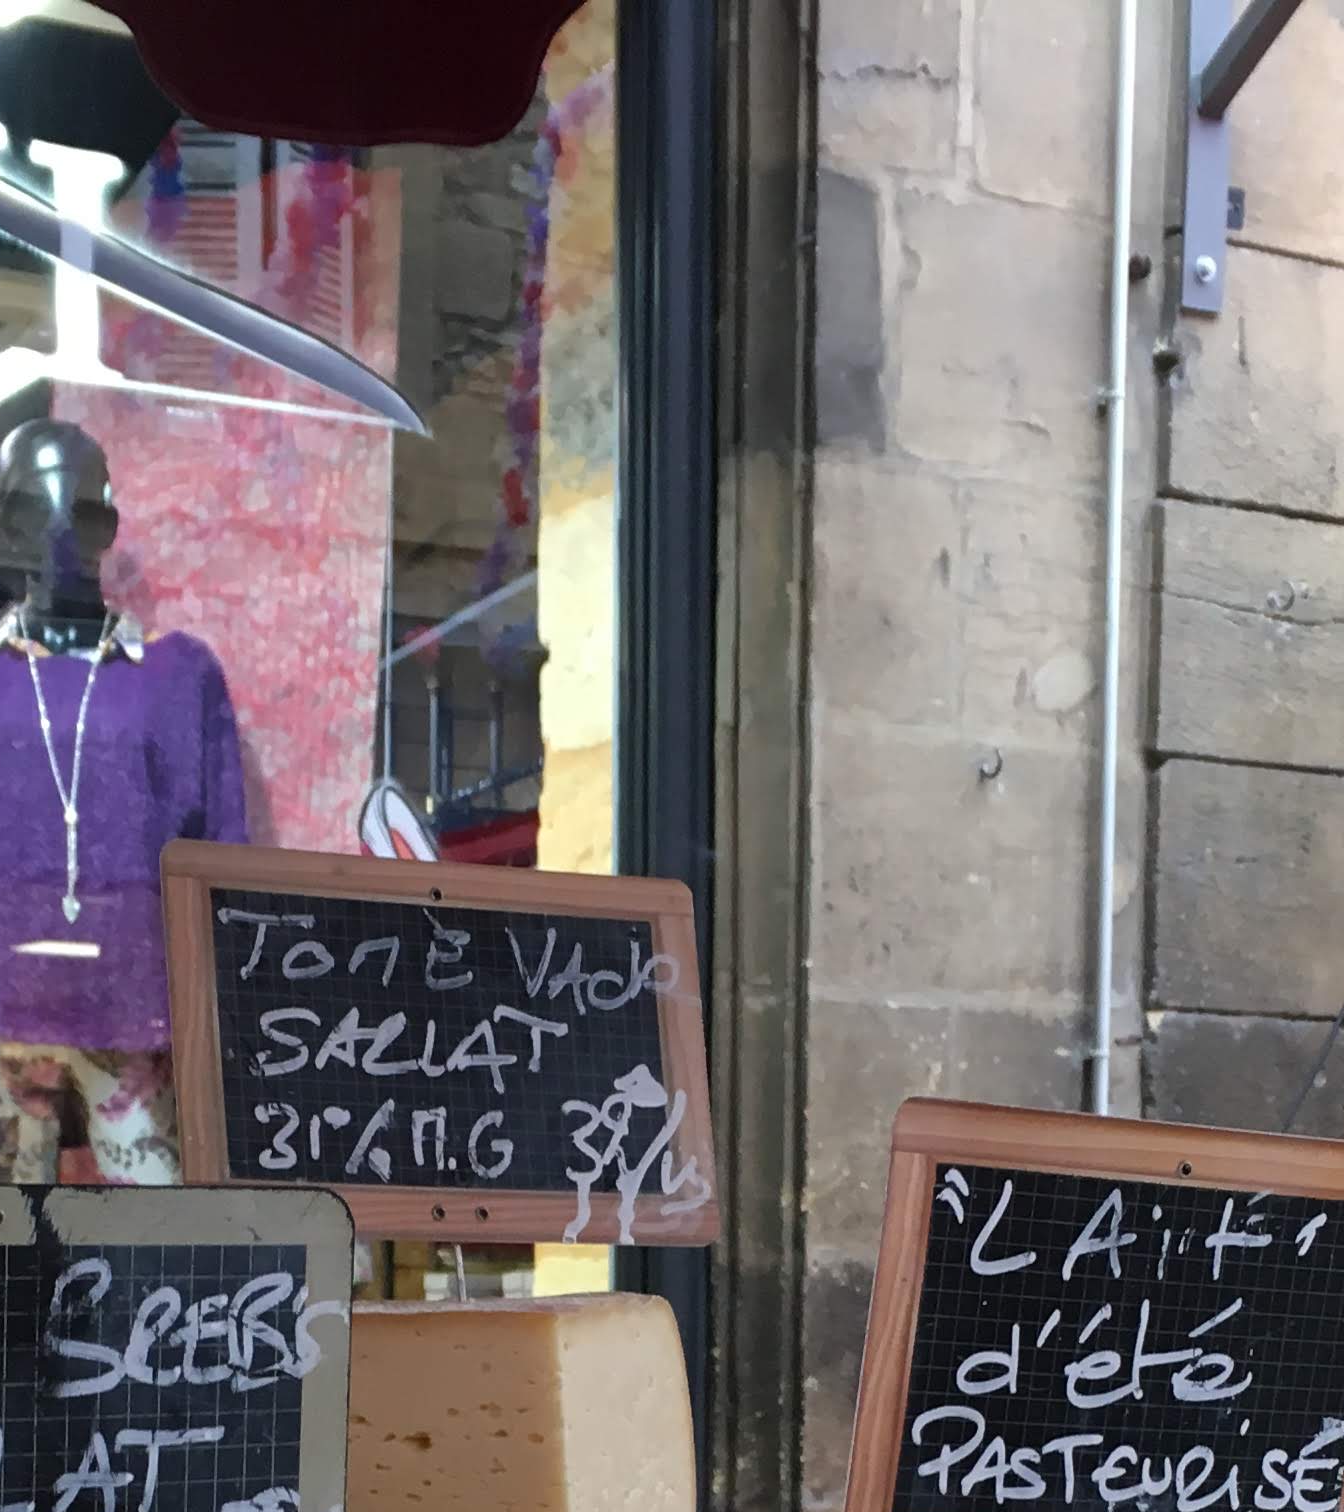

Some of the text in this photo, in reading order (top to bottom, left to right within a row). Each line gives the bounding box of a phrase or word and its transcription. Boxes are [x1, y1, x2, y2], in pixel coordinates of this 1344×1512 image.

[251, 1005, 567, 1094] SARLAT
[256, 1099, 394, 1182] 31%
[956, 1299, 1252, 1408] d'été
